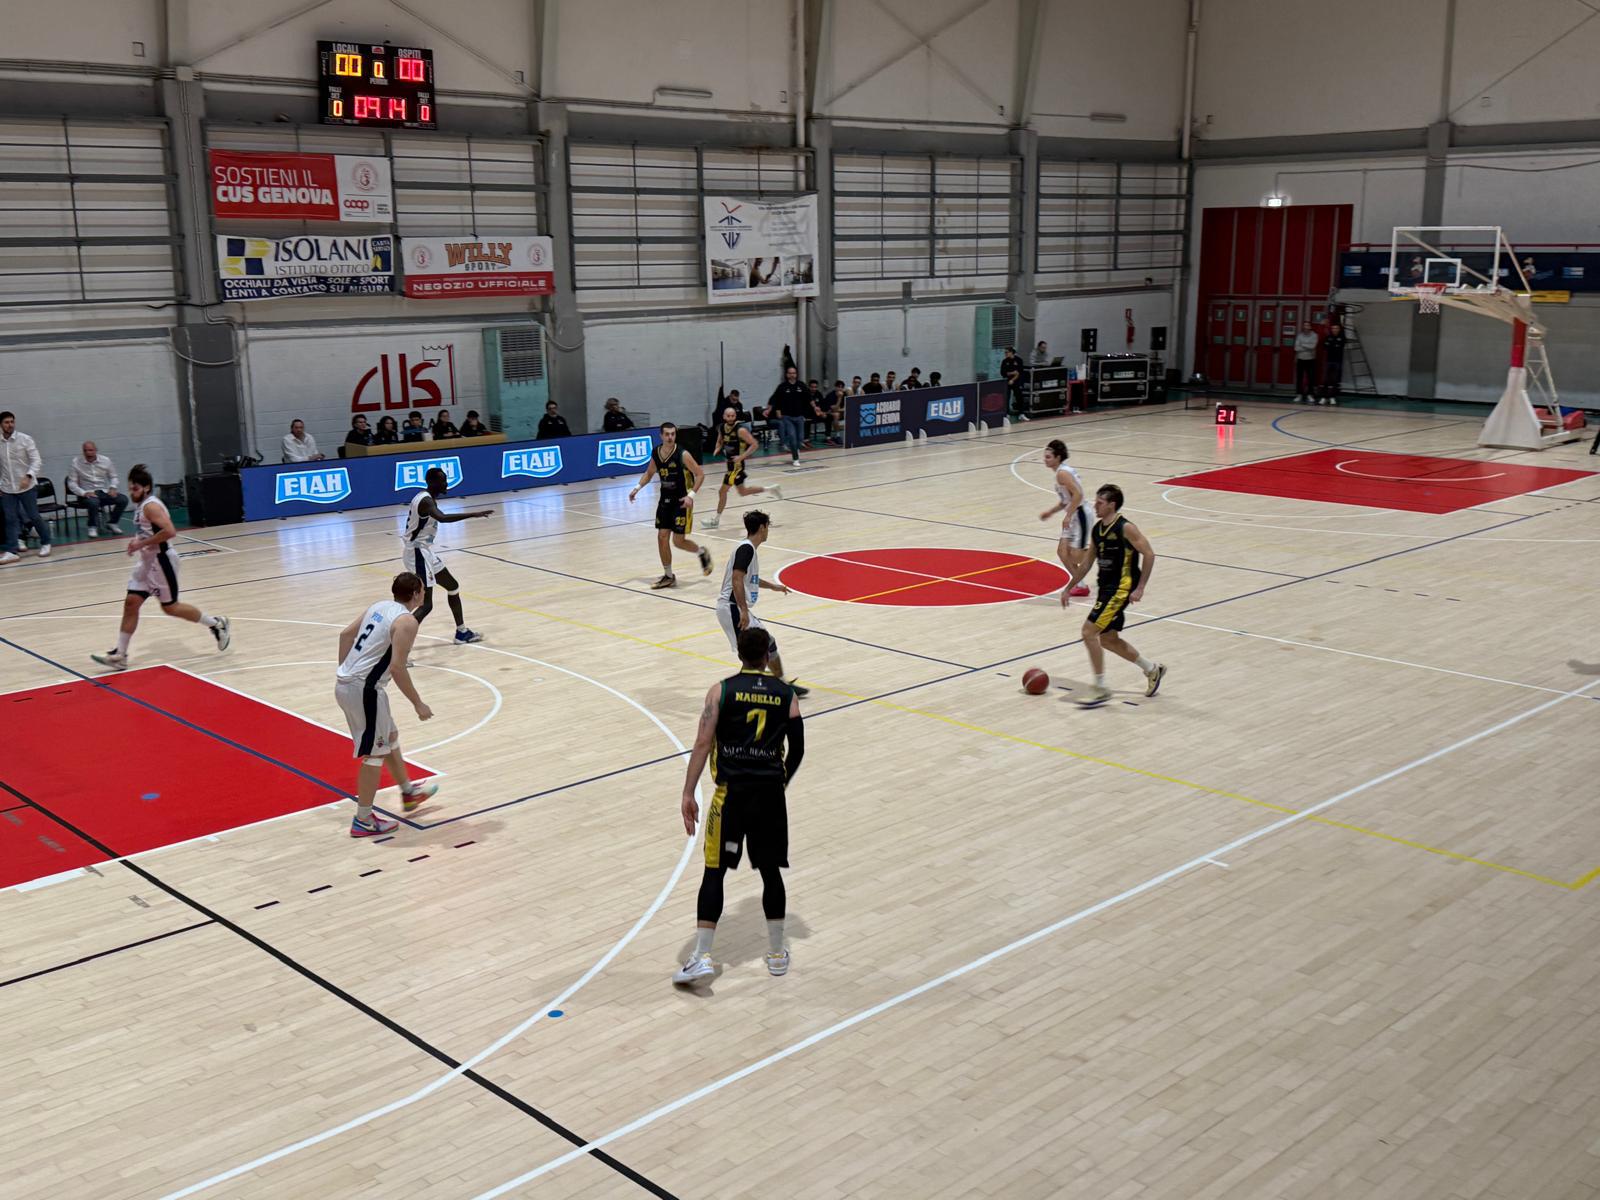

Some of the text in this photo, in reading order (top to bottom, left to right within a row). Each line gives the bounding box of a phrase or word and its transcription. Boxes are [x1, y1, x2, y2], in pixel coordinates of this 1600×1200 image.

[332, 43, 359, 54] LOCALI
[398, 48, 421, 59] OSPITI
[335, 53, 362, 77] 00
[399, 58, 424, 82] 00
[333, 100, 343, 117] 0
[420, 105, 430, 121] 0
[214, 166, 318, 187] SOSTIENI IL
[216, 185, 335, 206] CUS GENOVA
[343, 199, 369, 211] coop
[273, 238, 370, 263] ISOLANI
[444, 242, 513, 268] WILLY
[275, 264, 370, 276] ISTITUTO OTTICO
[464, 263, 497, 271] SPORT
[224, 279, 271, 289] OCCHIALI
[273, 278, 290, 287] DA
[292, 277, 318, 286] VISTA
[327, 277, 351, 285] SOLE
[360, 275, 390, 285] SPORT
[413, 279, 546, 291] NEGOZIO UFFICIALE
[225, 284, 391, 299] LENTI A CONTATTO SU MISURA
[930, 400, 961, 417] ELAH
[1217, 409, 1235, 422] 21
[604, 440, 648, 460] ELAH
[509, 451, 556, 471] ELAH
[284, 473, 343, 497] ELAH
[354, 623, 375, 652] 2
[746, 708, 767, 742] 7
